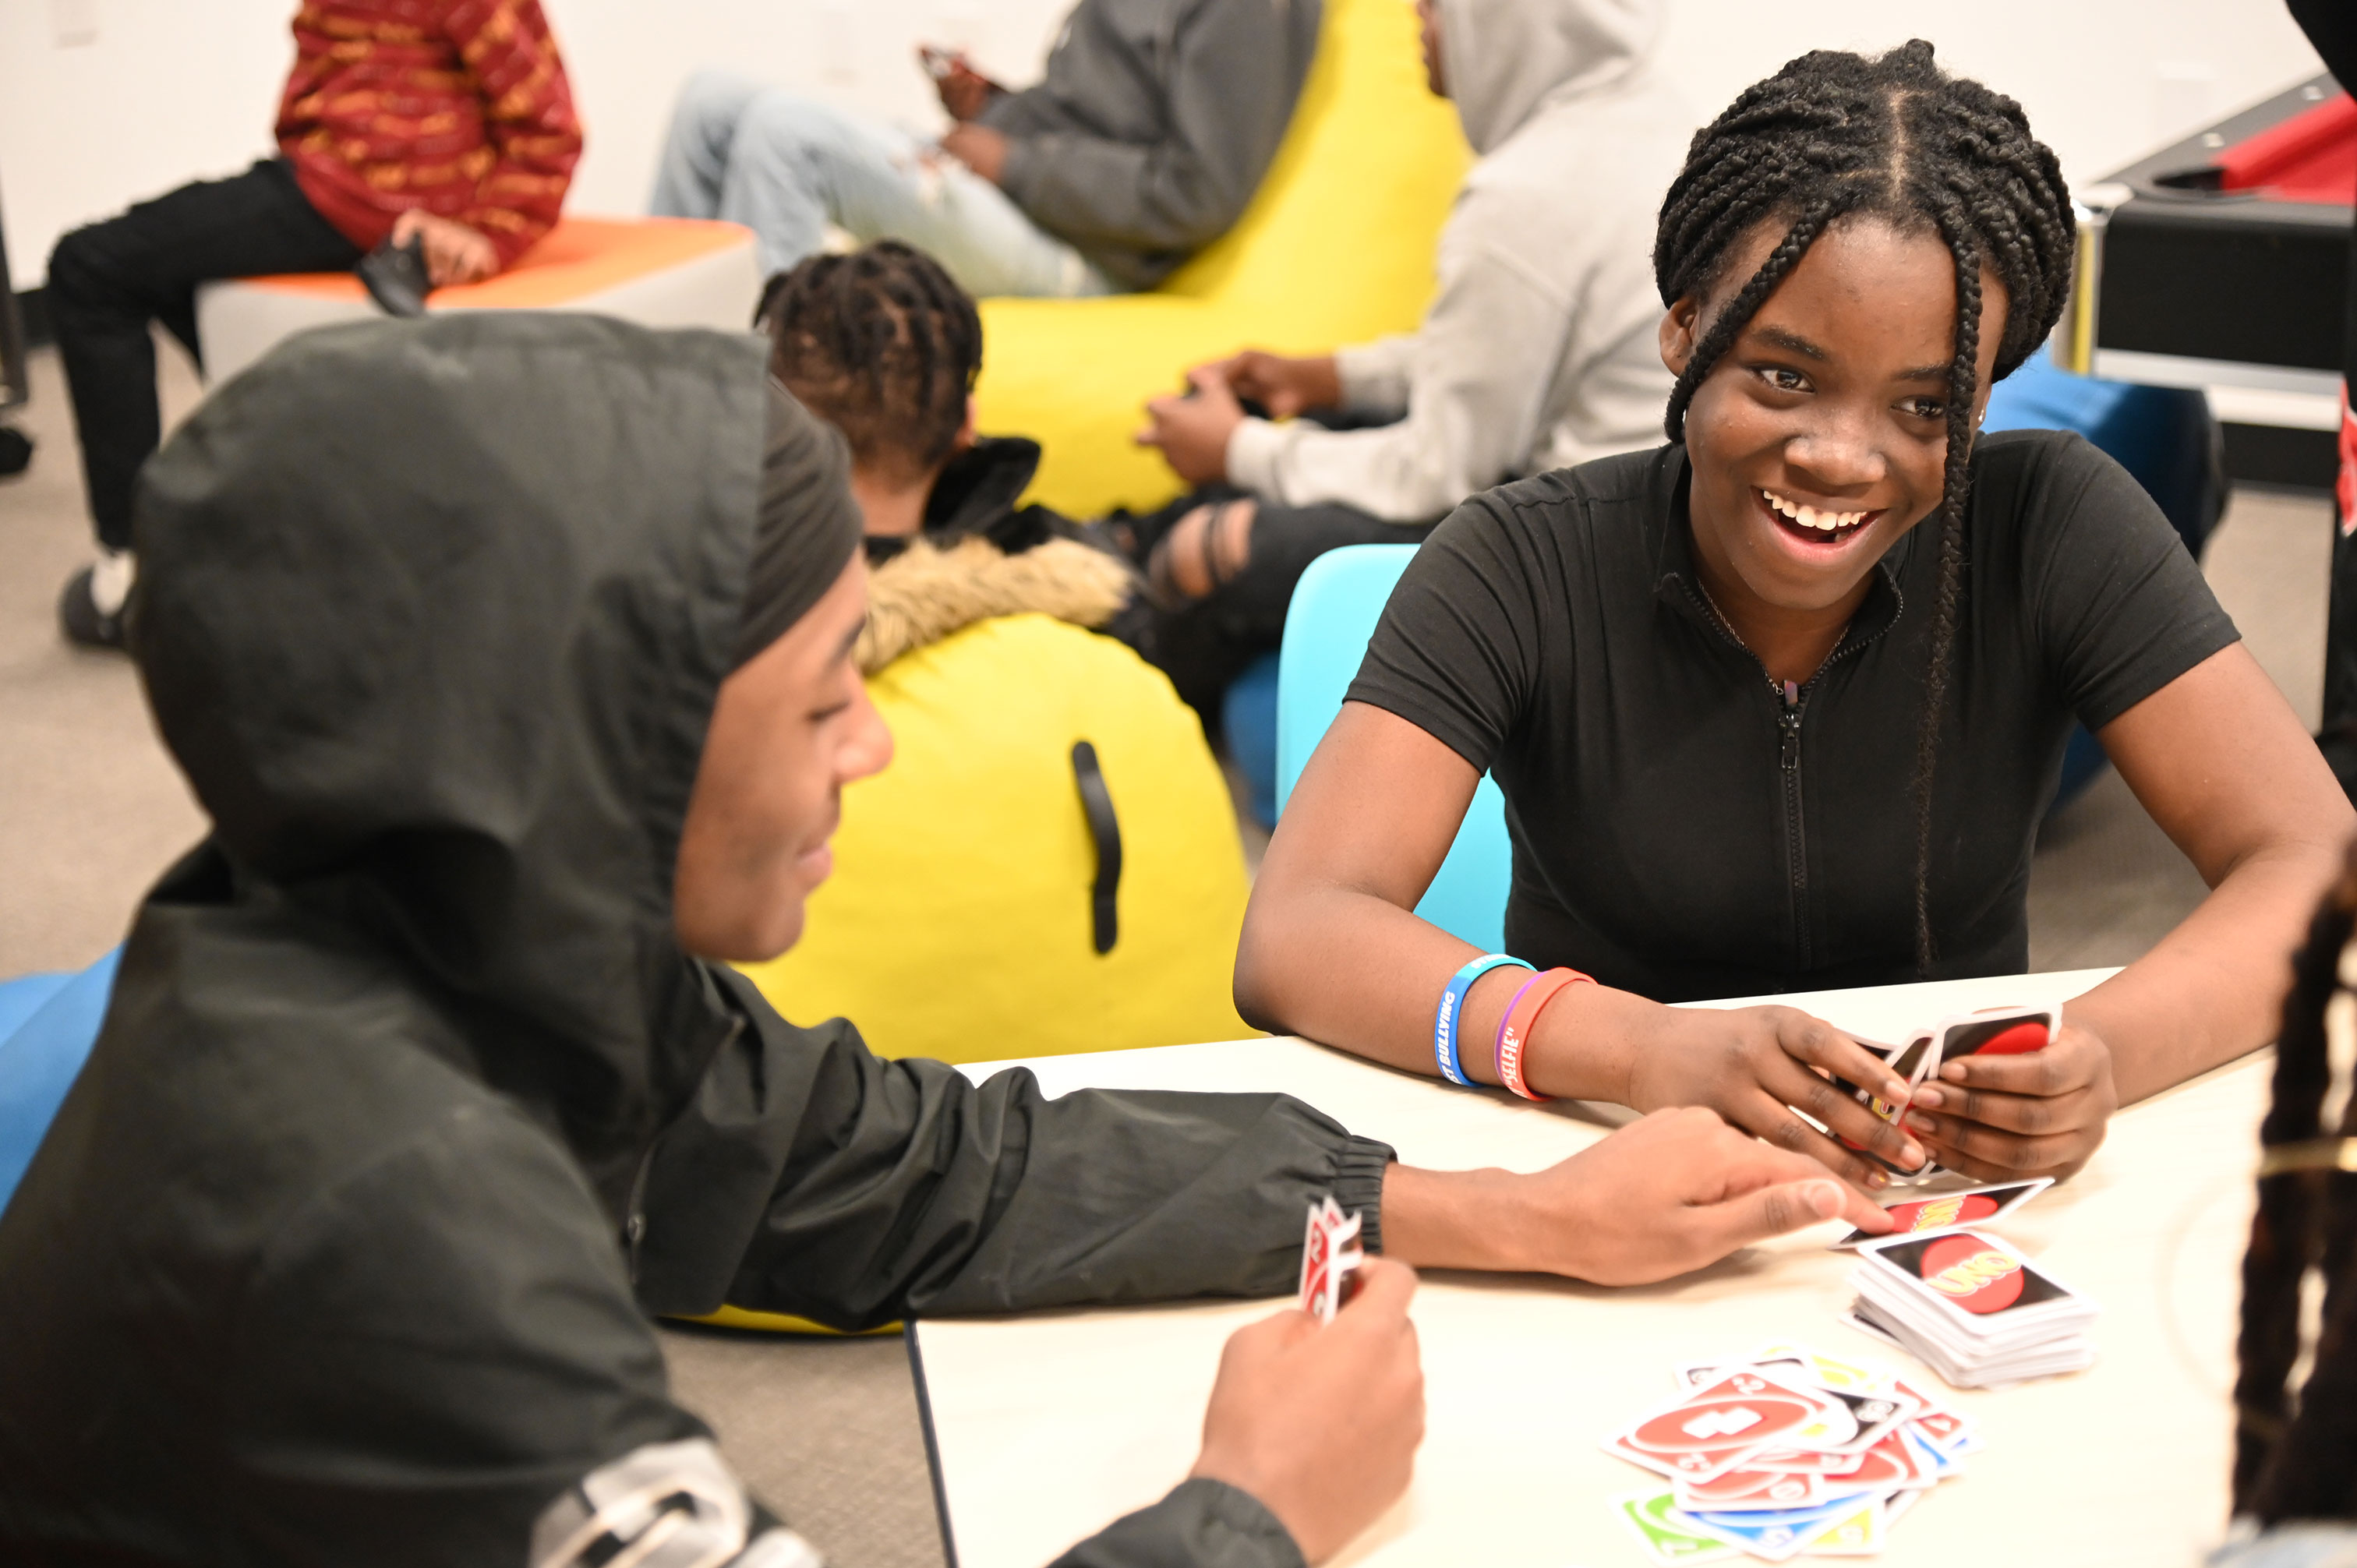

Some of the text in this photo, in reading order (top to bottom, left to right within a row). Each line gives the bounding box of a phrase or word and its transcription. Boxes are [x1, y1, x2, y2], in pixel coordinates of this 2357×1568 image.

[1437, 991, 1455, 1066] BULLYING
[1501, 1026, 1519, 1086] "SELFIE"
[1925, 1251, 2021, 1297] UNO
